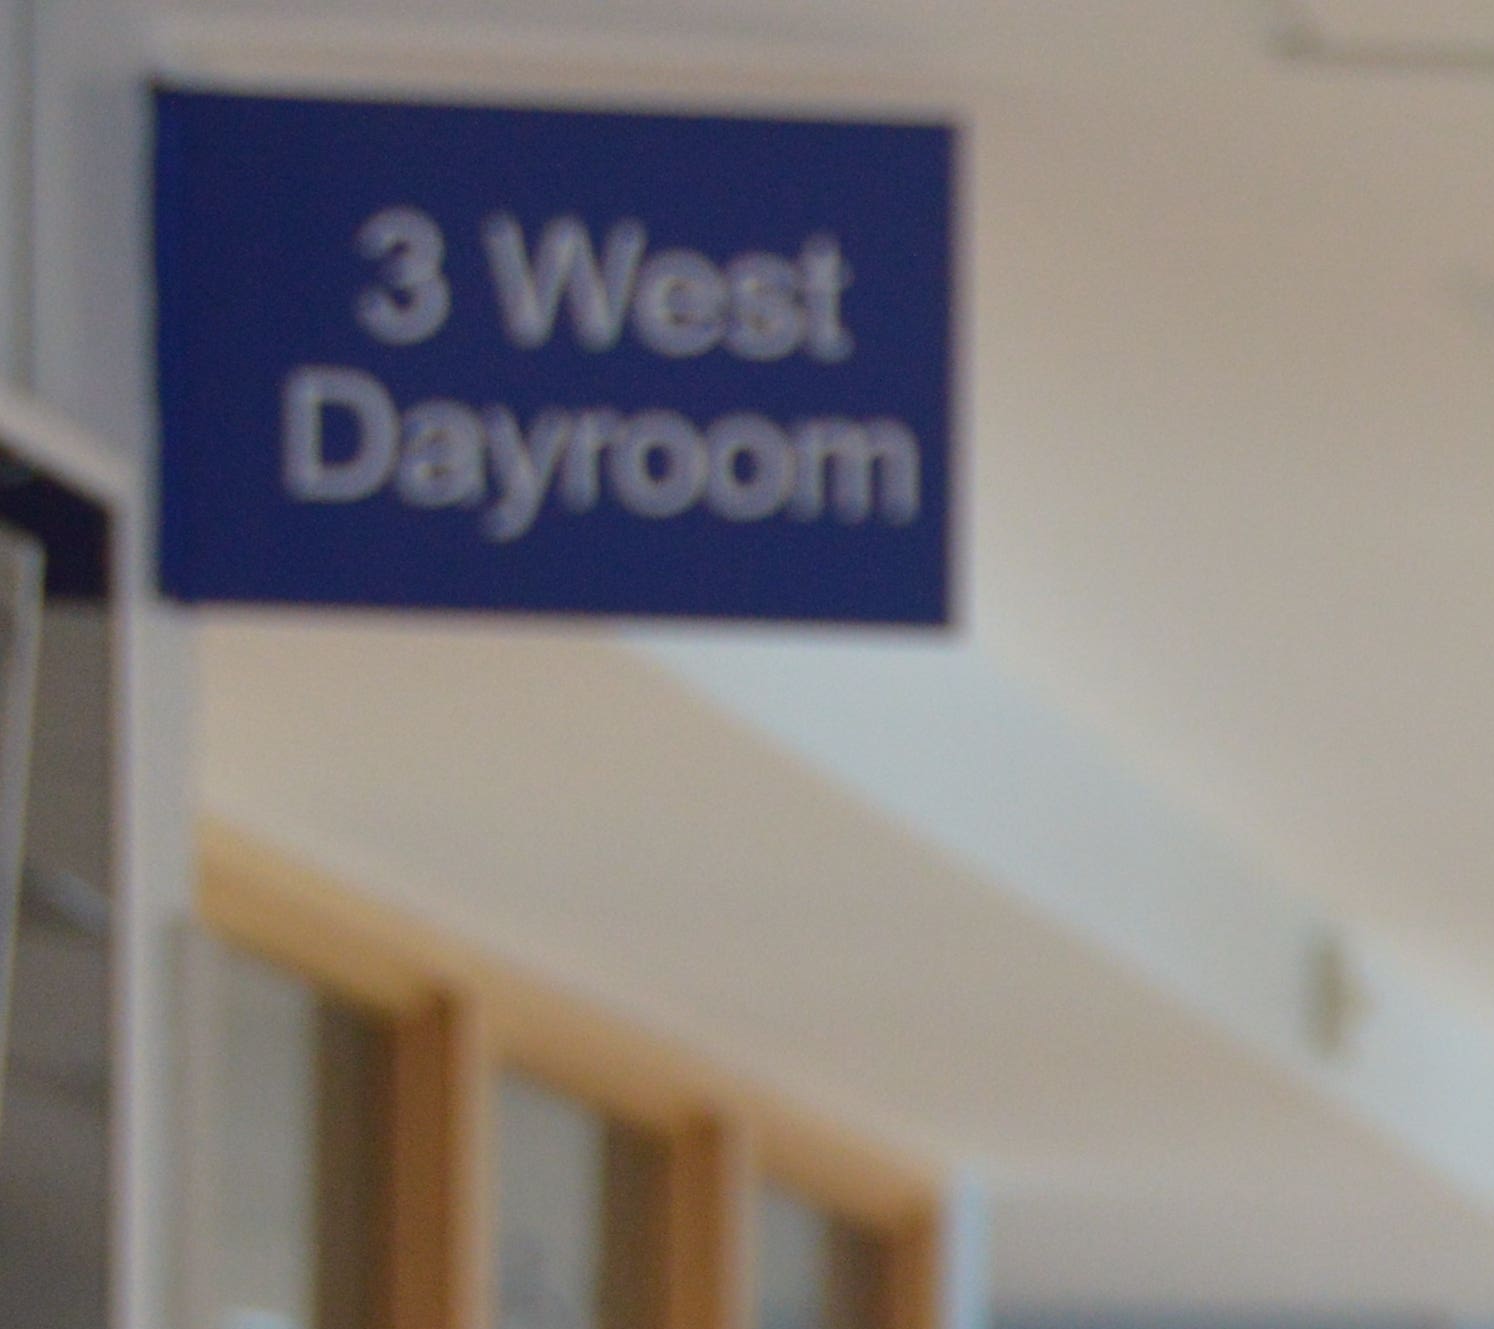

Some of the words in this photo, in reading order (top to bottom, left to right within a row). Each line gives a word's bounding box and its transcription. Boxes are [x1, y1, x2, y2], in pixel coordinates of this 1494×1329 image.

[354, 206, 451, 346] 3
[481, 210, 854, 364] West
[280, 364, 922, 542] Dayroom
